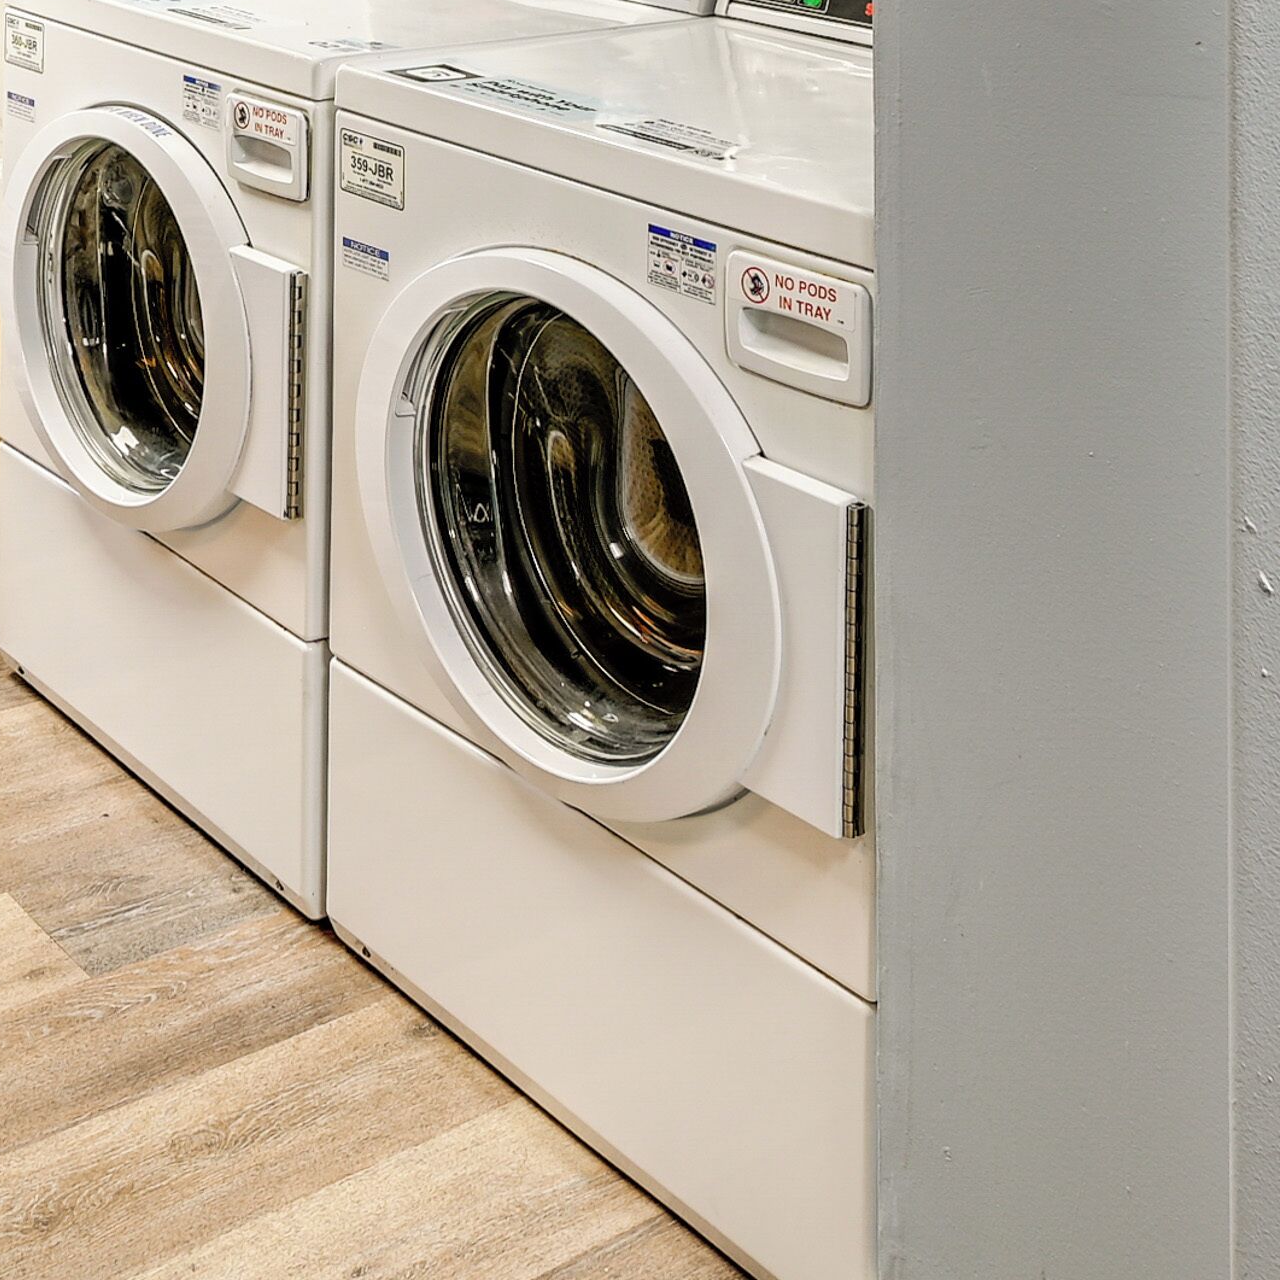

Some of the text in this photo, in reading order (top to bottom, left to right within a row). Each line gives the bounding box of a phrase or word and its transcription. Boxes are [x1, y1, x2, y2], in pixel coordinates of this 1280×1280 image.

[252, 106, 288, 125] NO PODS
[255, 122, 284, 139] IN TRAY
[350, 156, 394, 182] 359-JBR
[350, 240, 381, 257] NOTICE
[775, 274, 838, 302] NO PODS
[779, 296, 832, 322] IN TRAY
